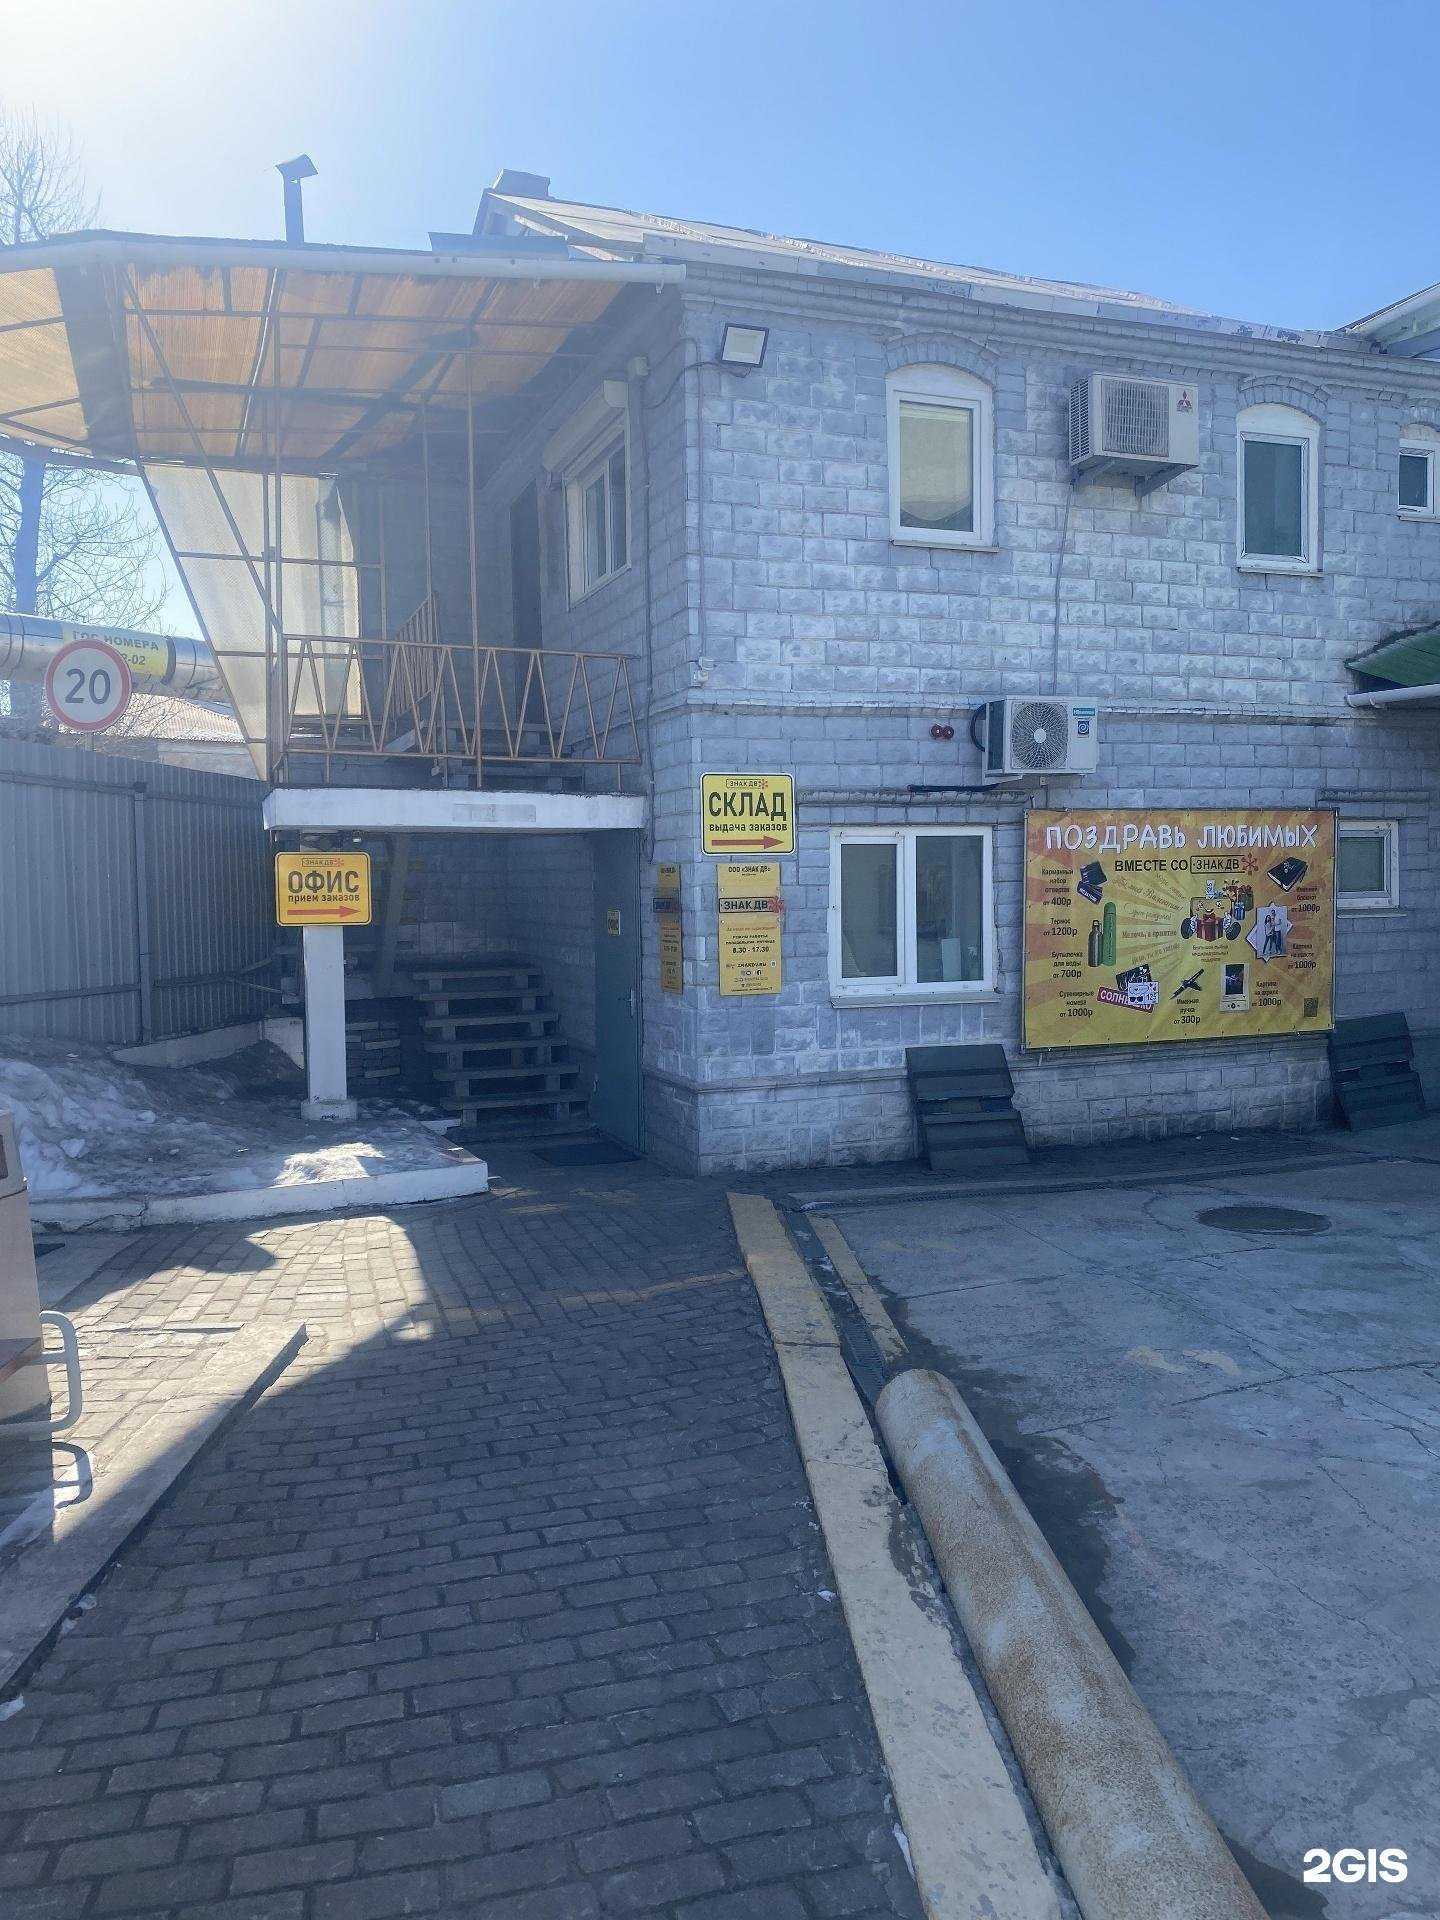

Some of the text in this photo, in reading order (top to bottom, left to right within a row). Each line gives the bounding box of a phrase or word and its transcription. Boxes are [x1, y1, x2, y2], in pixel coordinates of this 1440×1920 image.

[104, 635, 159, 651] НОМЕРА
[65, 668, 111, 704] 20
[708, 791, 787, 821] СКЛАД
[709, 823, 788, 833] выдача заказов
[1045, 823, 1319, 854] ПОЗДРАВЬ ЛЮБИМЫХ
[1114, 859, 1167, 872] ВМЕСТЕ
[1170, 859, 1189, 872] СО
[288, 870, 360, 894] ОФИС
[288, 894, 360, 904] прием заказов
[1060, 969, 1082, 979] 700р
[1181, 1015, 1201, 1025] 300р
